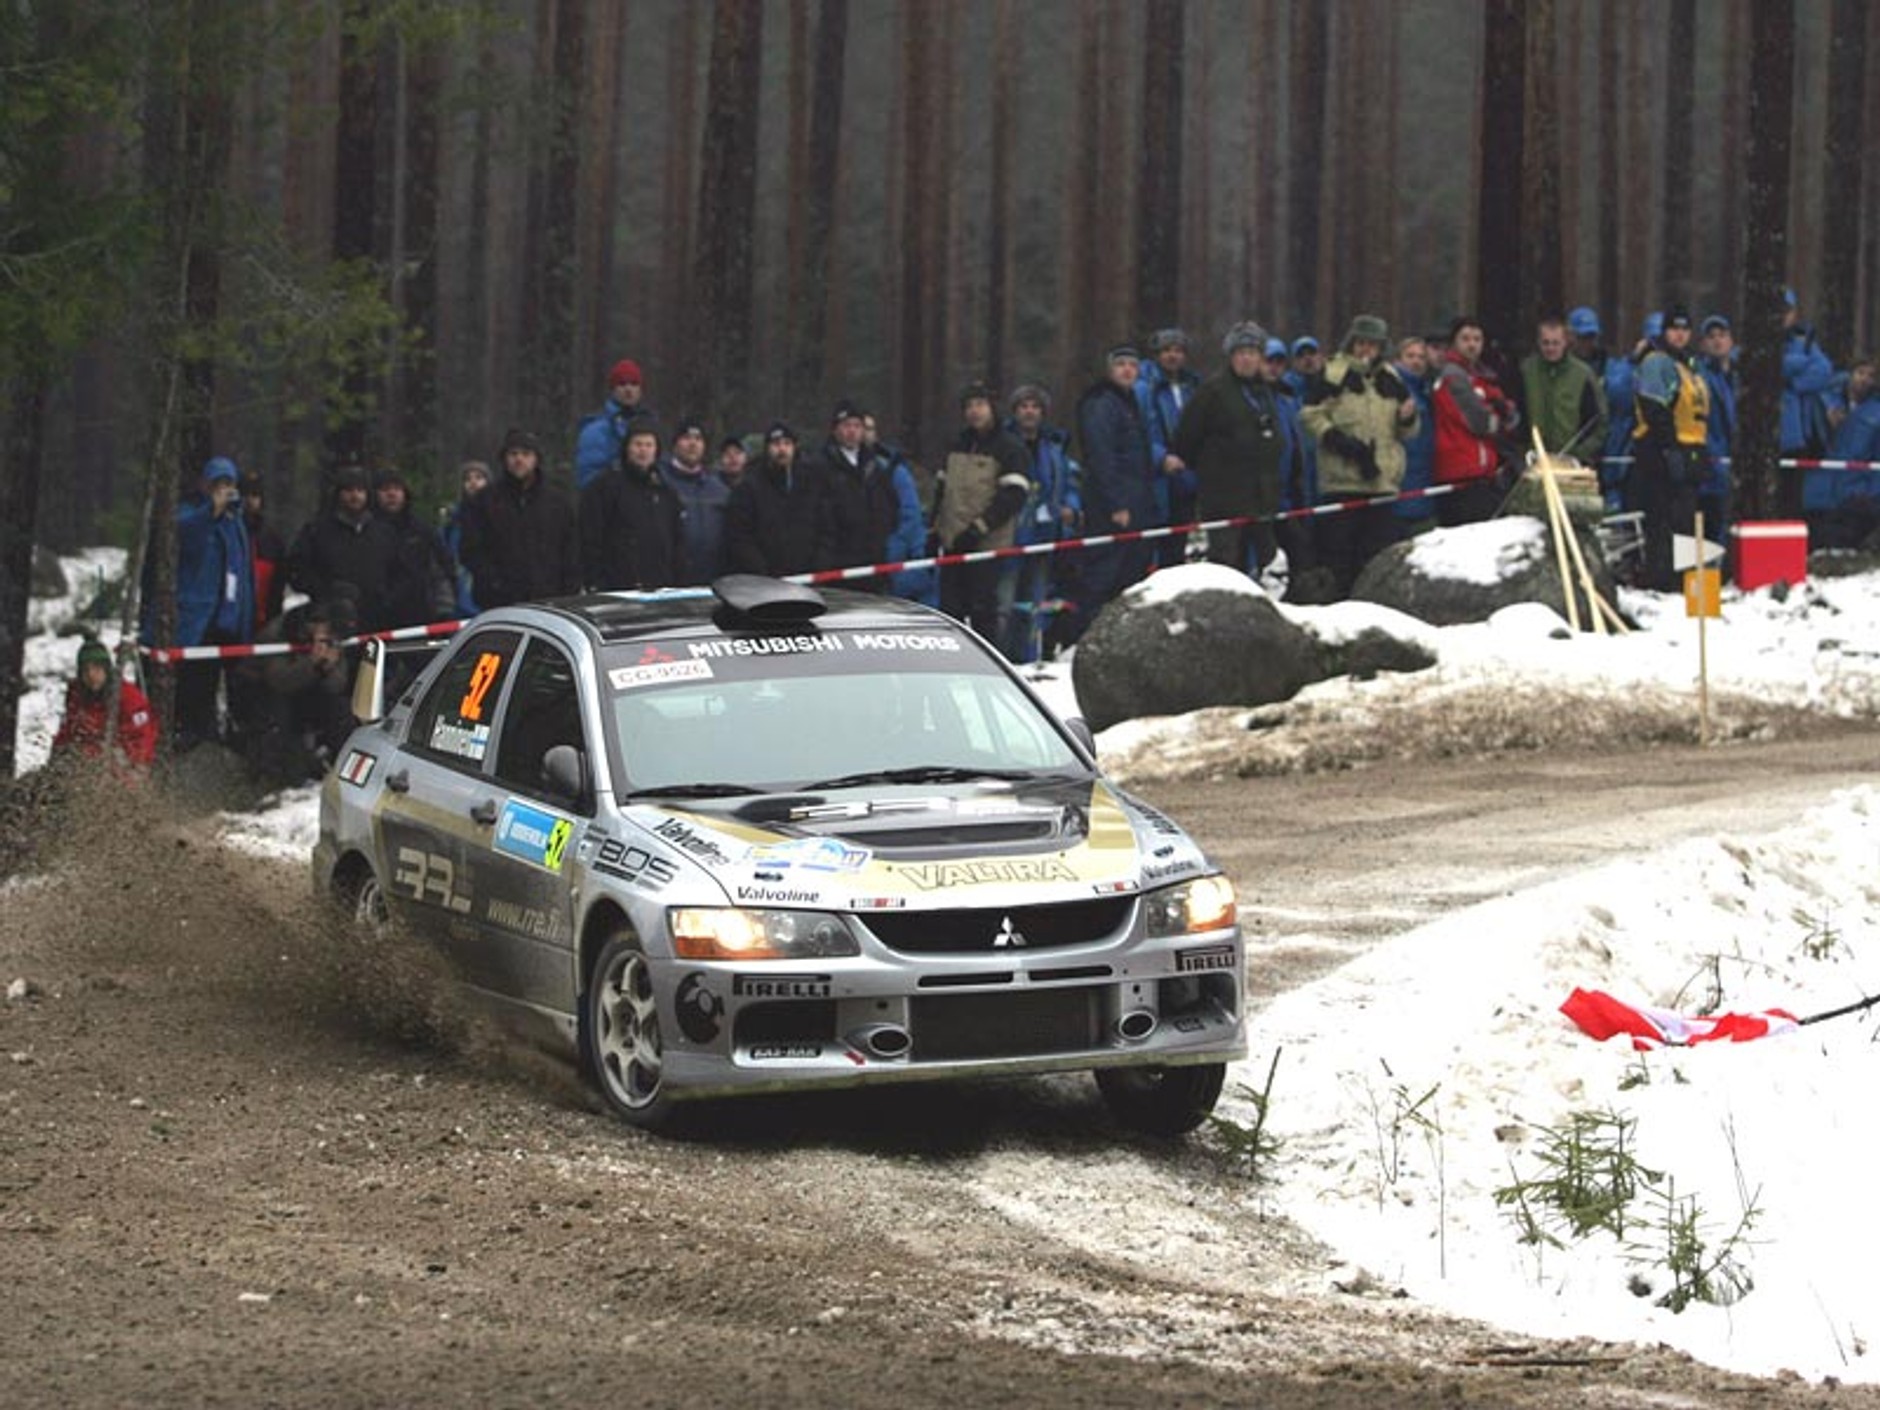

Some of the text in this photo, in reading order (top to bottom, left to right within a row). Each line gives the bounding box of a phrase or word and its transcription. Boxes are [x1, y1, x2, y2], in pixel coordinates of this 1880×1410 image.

[688, 634, 960, 658] MITSUBISHI MOTORS
[460, 653, 500, 720] 52
[899, 859, 1080, 891] VALTRA
[736, 886, 820, 903] Valvoline
[1174, 944, 1236, 972] PIRELLI
[733, 973, 832, 996] PIRELLI
